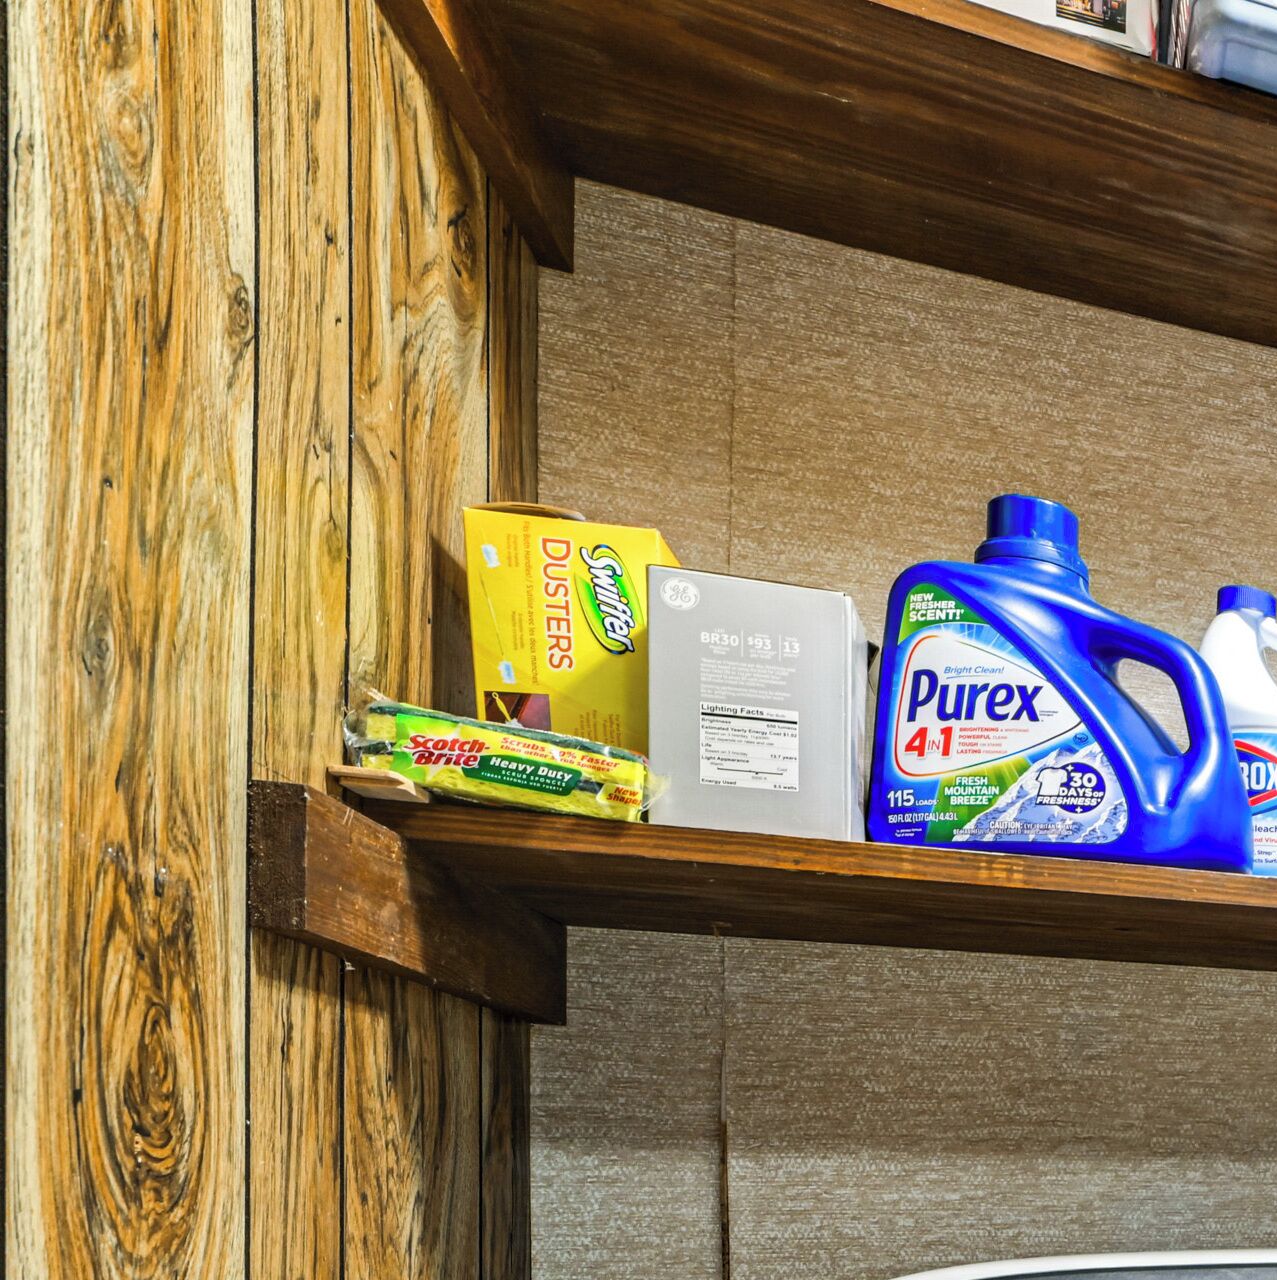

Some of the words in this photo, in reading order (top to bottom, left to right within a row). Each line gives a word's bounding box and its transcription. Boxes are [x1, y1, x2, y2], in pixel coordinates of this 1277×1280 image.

[523, 534, 532, 549] Both
[542, 537, 574, 670] DUSTERS
[579, 546, 636, 653] Swiffer
[910, 593, 934, 602] NEW
[910, 601, 956, 610] FRESHER
[527, 610, 535, 626] avec
[528, 626, 536, 637] les
[528, 638, 537, 654] deux
[700, 632, 739, 646] BR30
[747, 636, 772, 650] $93
[784, 642, 800, 653] 13
[944, 666, 972, 675] Bright
[974, 666, 1004, 674] Clean!
[907, 669, 1043, 722] Purex
[702, 704, 738, 714] Lighting
[740, 708, 764, 716] Facts
[403, 734, 490, 754] Scotch-
[412, 750, 479, 767] Brite
[501, 744, 522, 754] than
[524, 749, 548, 759] other
[502, 737, 545, 752] Scrubs
[581, 755, 620, 768] Faster
[490, 756, 536, 774] Heavy
[538, 766, 574, 782] Duty
[502, 770, 526, 780] SCRUB
[530, 776, 566, 787] SPONGES
[956, 776, 988, 786] FRESH
[1070, 773, 1097, 788] 30
[614, 786, 638, 798] New
[944, 786, 1000, 796] MOUNTAIN
[1059, 787, 1093, 798] DAYS
[886, 789, 914, 808] 115
[938, 812, 954, 822] 4.43
[990, 820, 1022, 830] CAUTION:
